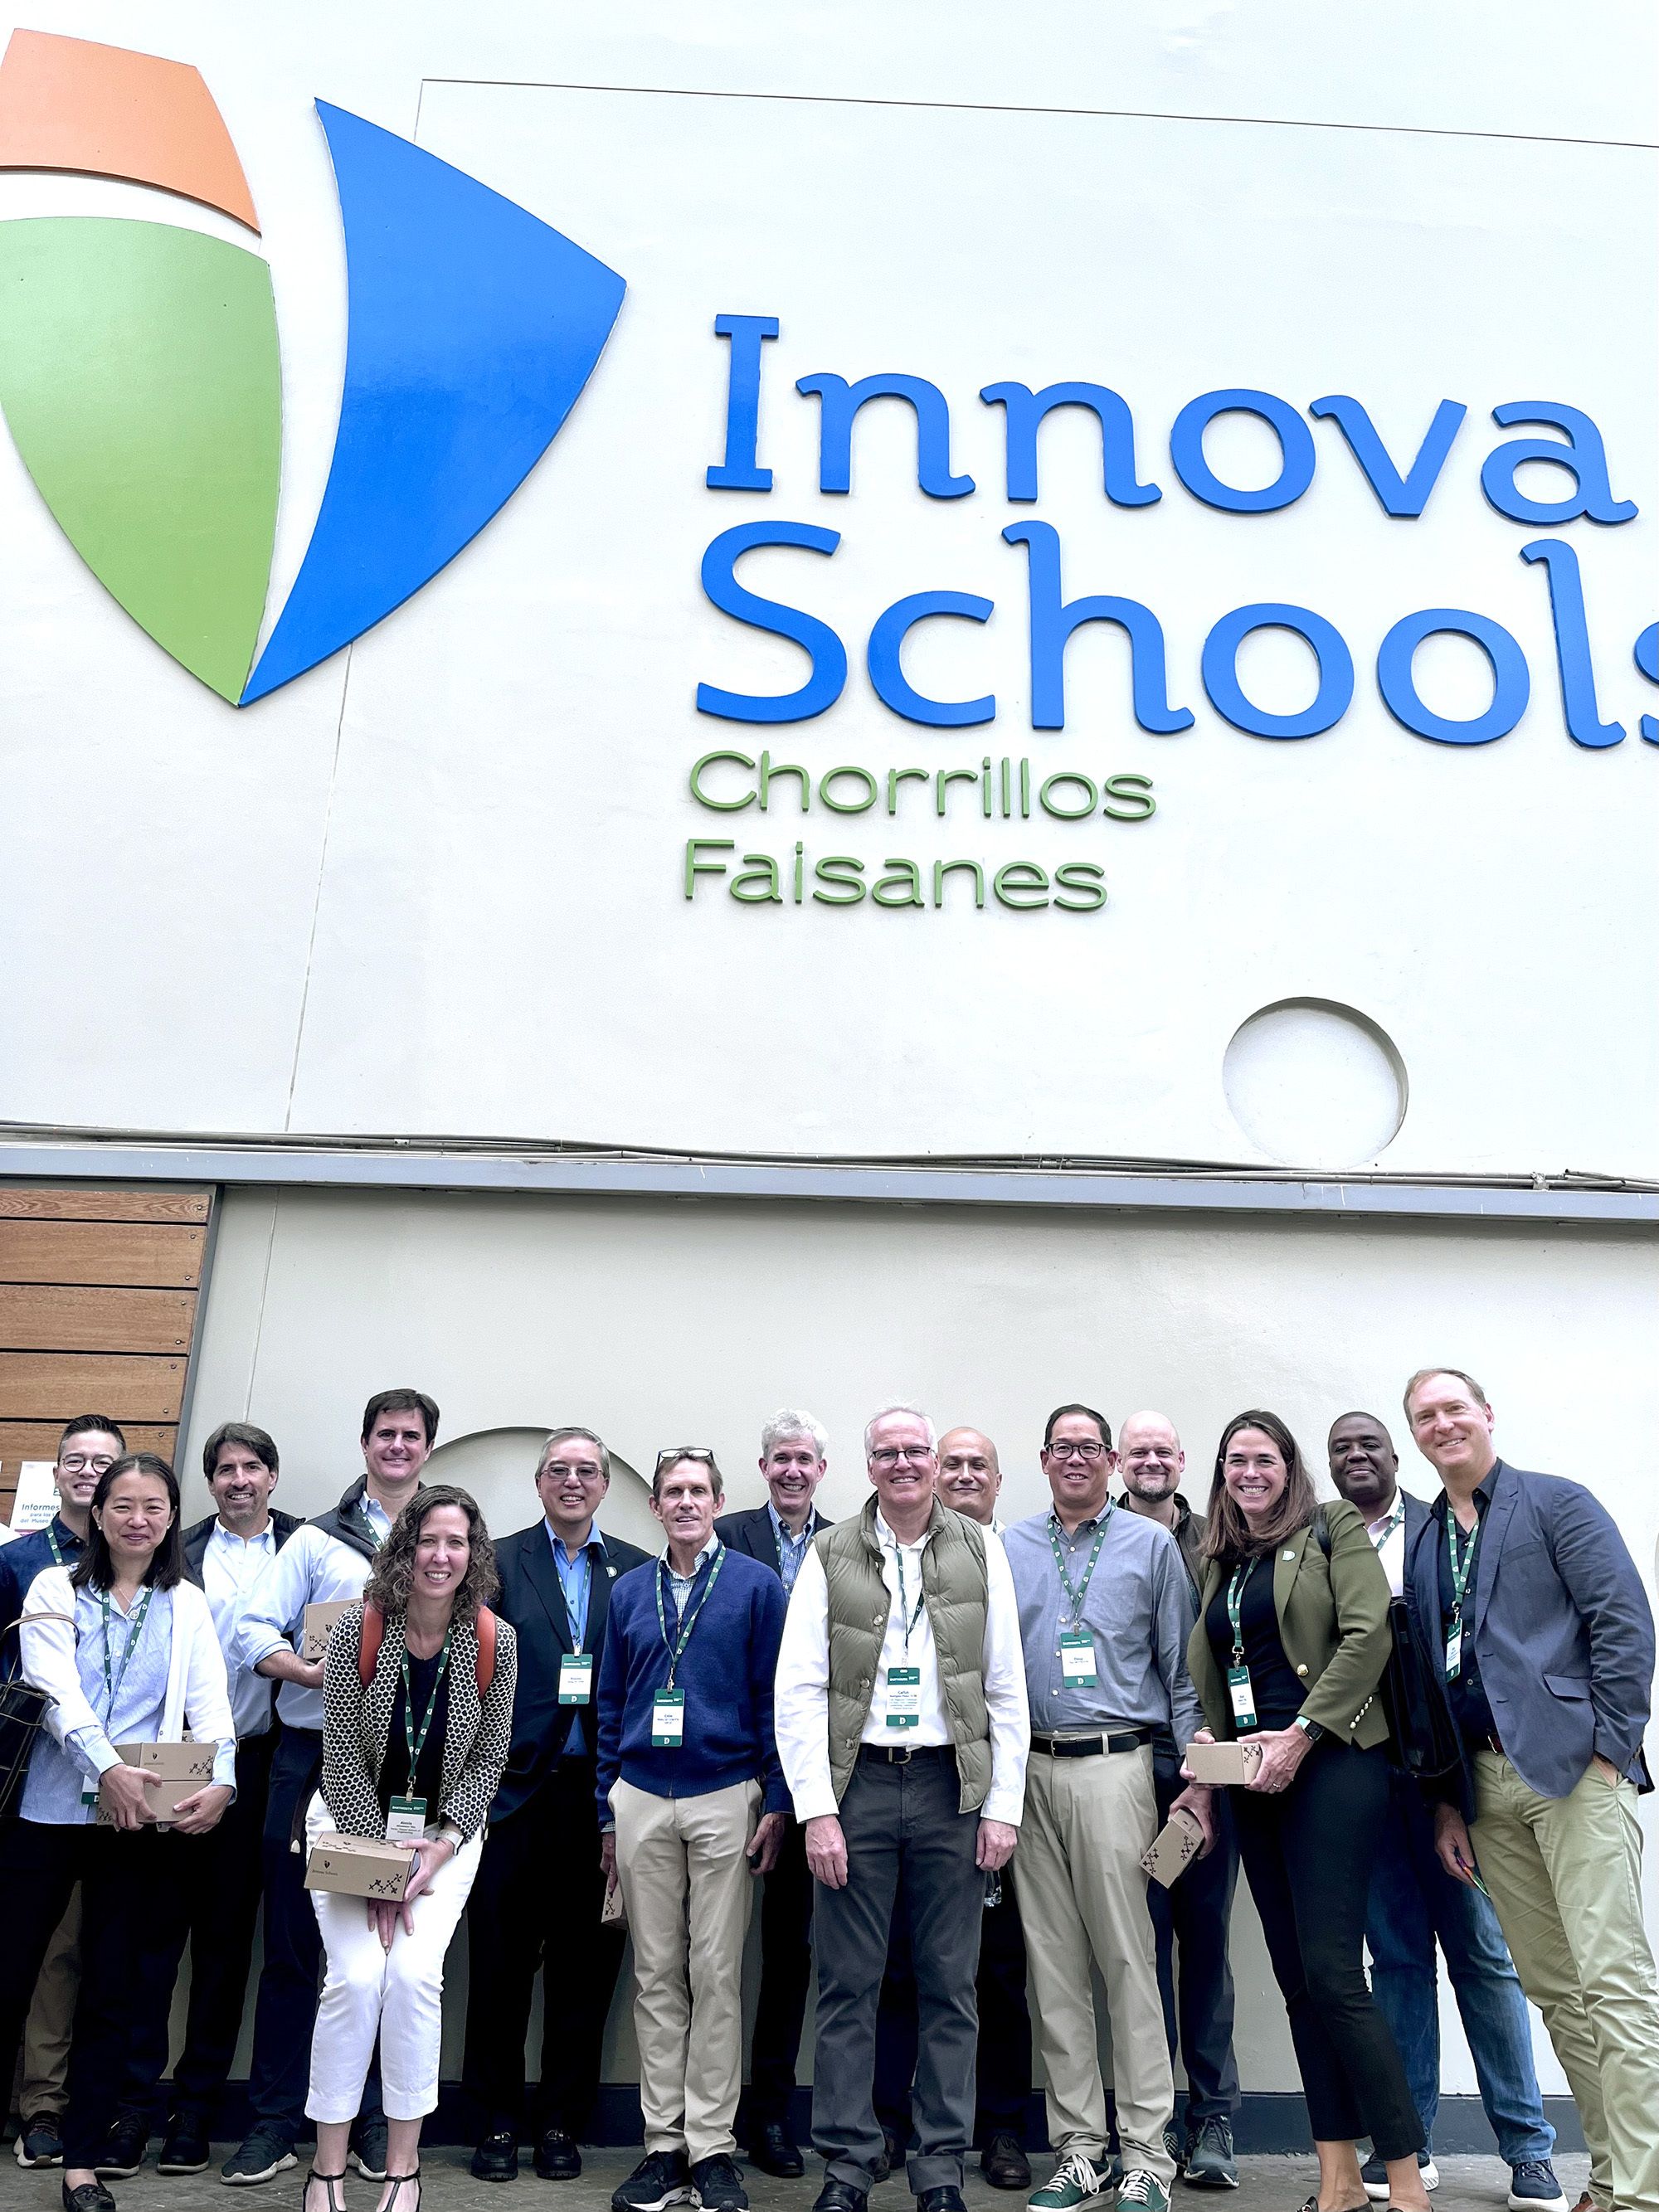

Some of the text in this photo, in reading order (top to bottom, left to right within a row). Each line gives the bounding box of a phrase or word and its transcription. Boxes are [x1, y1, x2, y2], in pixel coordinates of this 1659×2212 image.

[706, 314, 1640, 527] Innova
[695, 520, 1659, 750] School
[689, 749, 1156, 821] Chorrillos
[685, 838, 1108, 911] Faisanes
[22, 1503, 61, 1511] Informes
[899, 1717, 907, 1725] D
[1243, 1716, 1248, 1724] D
[664, 1737, 670, 1745] D
